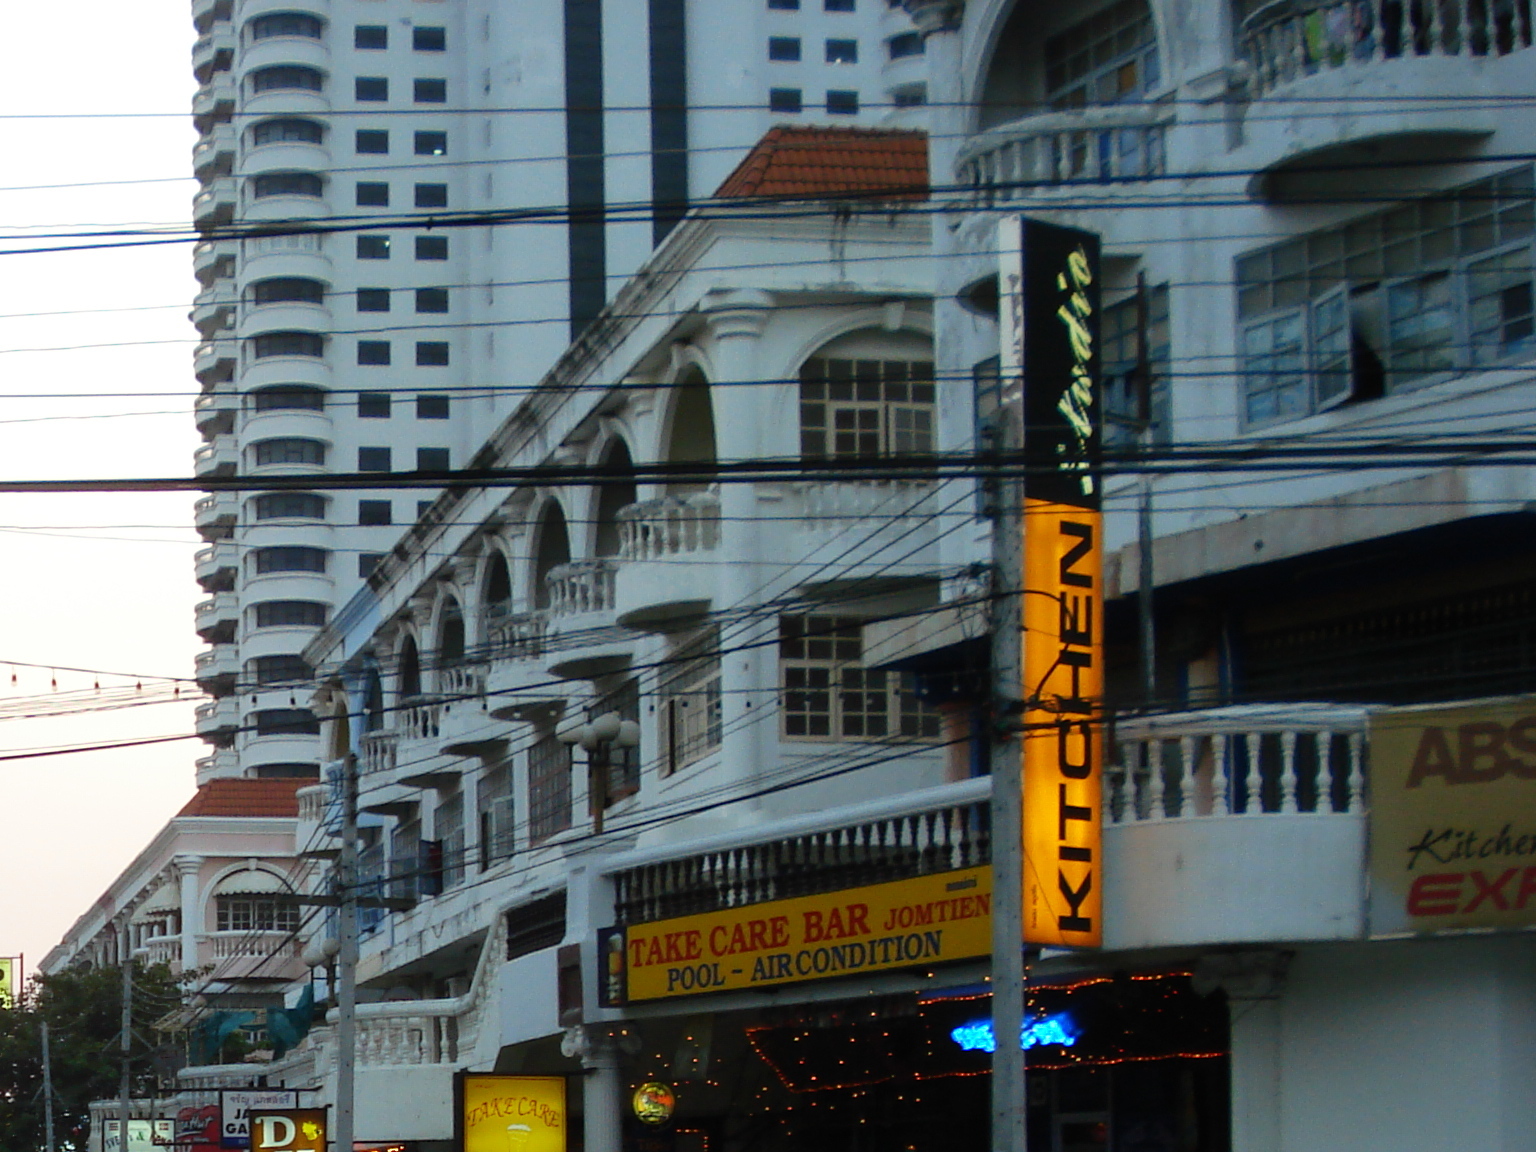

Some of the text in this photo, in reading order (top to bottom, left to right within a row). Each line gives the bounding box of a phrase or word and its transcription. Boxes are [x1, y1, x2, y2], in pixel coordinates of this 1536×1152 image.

[1058, 521, 1093, 933] KITCHEN
[629, 929, 703, 968] TAKE
[709, 916, 791, 957] CARE
[803, 903, 871, 944] BAR
[884, 892, 992, 932] JOMTIEN
[667, 963, 726, 992] POOL
[467, 1096, 560, 1127] TAKE CARE
[254, 1115, 296, 1148] D
